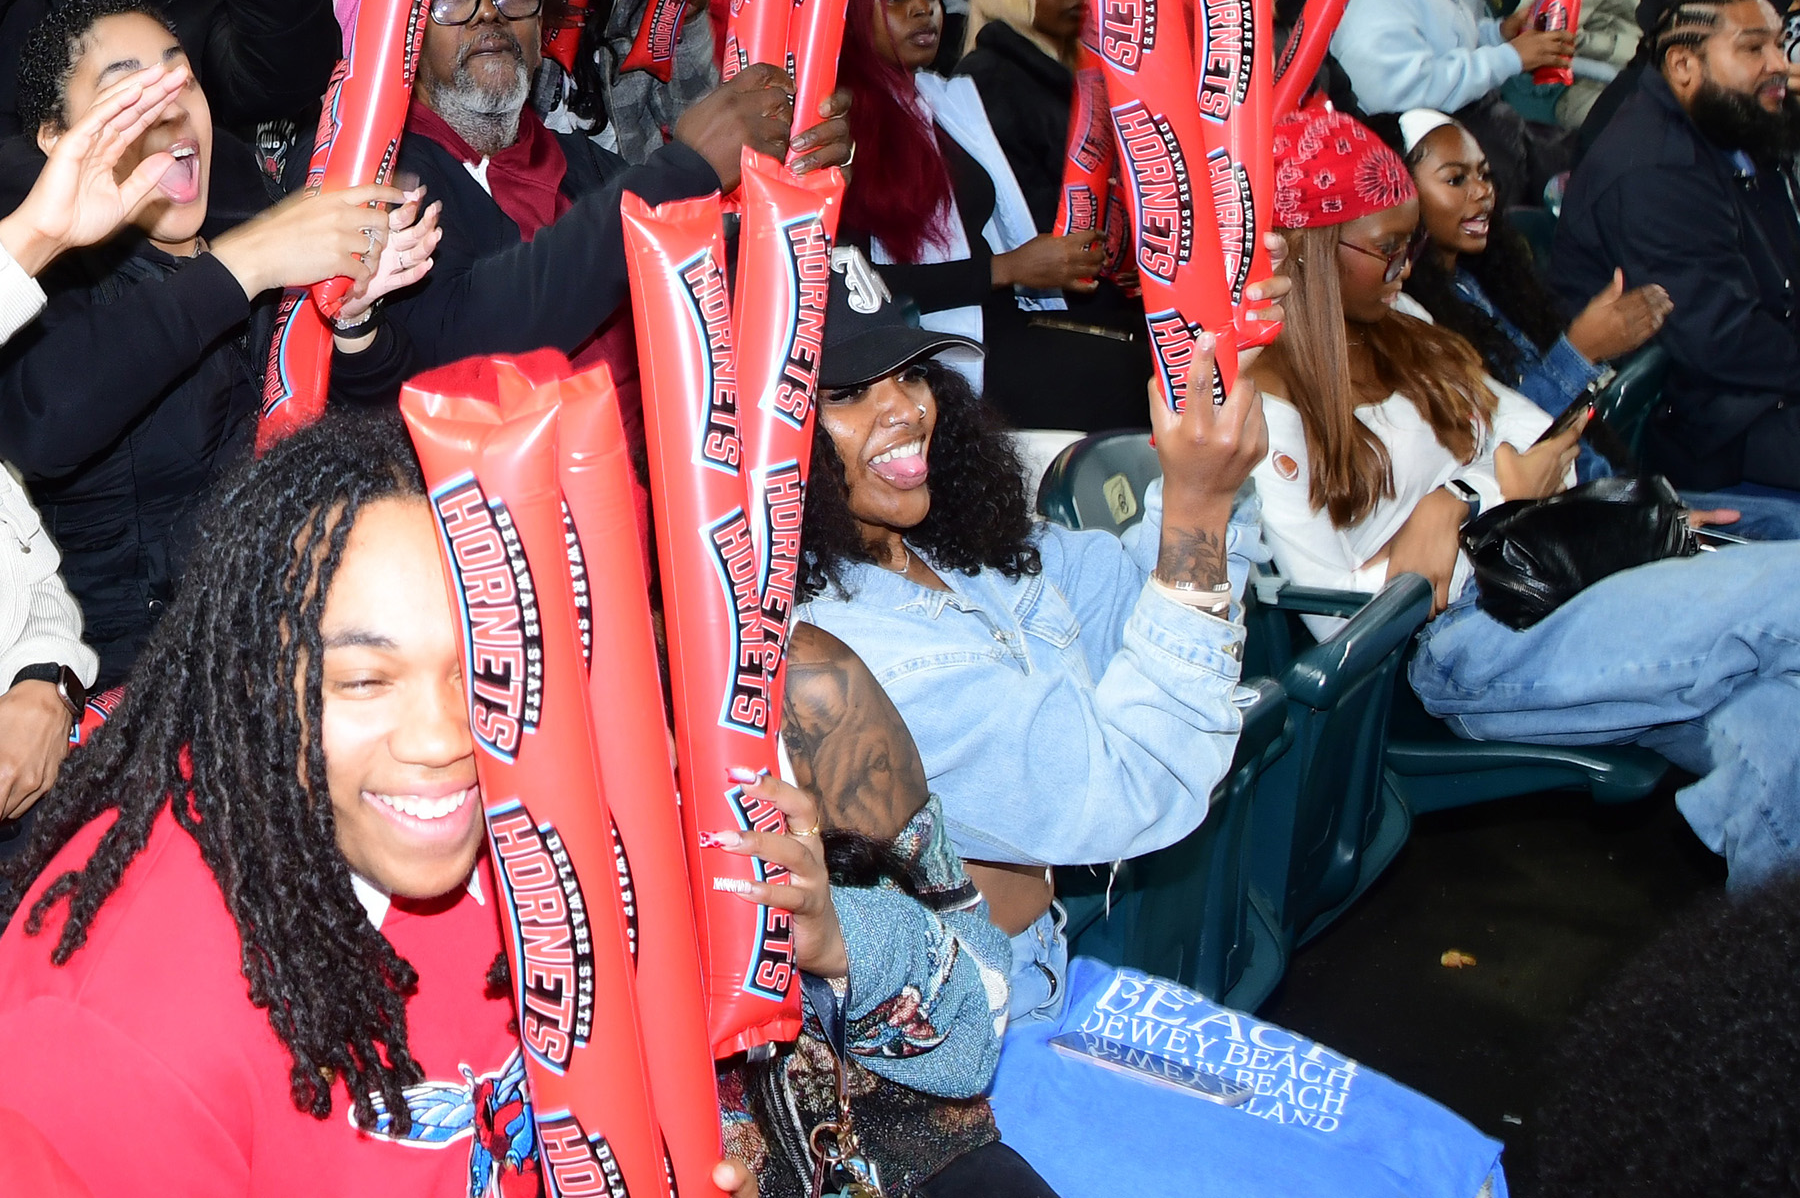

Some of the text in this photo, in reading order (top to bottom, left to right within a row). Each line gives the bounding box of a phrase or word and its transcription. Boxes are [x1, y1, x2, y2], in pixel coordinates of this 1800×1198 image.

[403, 1, 419, 79] DELAWARE
[1235, 55, 1251, 99] STATE
[376, 140, 395, 185] STATE
[1117, 110, 1179, 278] HORNETS
[1159, 122, 1190, 258] DELAWARE STATE
[1232, 171, 1254, 301] DELAWARE STATE
[263, 294, 297, 413] HORNETS
[686, 261, 740, 473] HORNETS
[774, 225, 829, 426] HORNETS
[442, 496, 525, 761] HORNETS
[496, 508, 542, 725] DELAWARE STATE
[713, 518, 768, 732] HORNETS
[760, 471, 800, 679] HORNETS
[493, 814, 575, 1067] HORNETS
[547, 833, 594, 1041] DELAWARE STATE
[1077, 1007, 1354, 1091] DEWEY BEACH
[1235, 1069, 1349, 1115] BEACH
